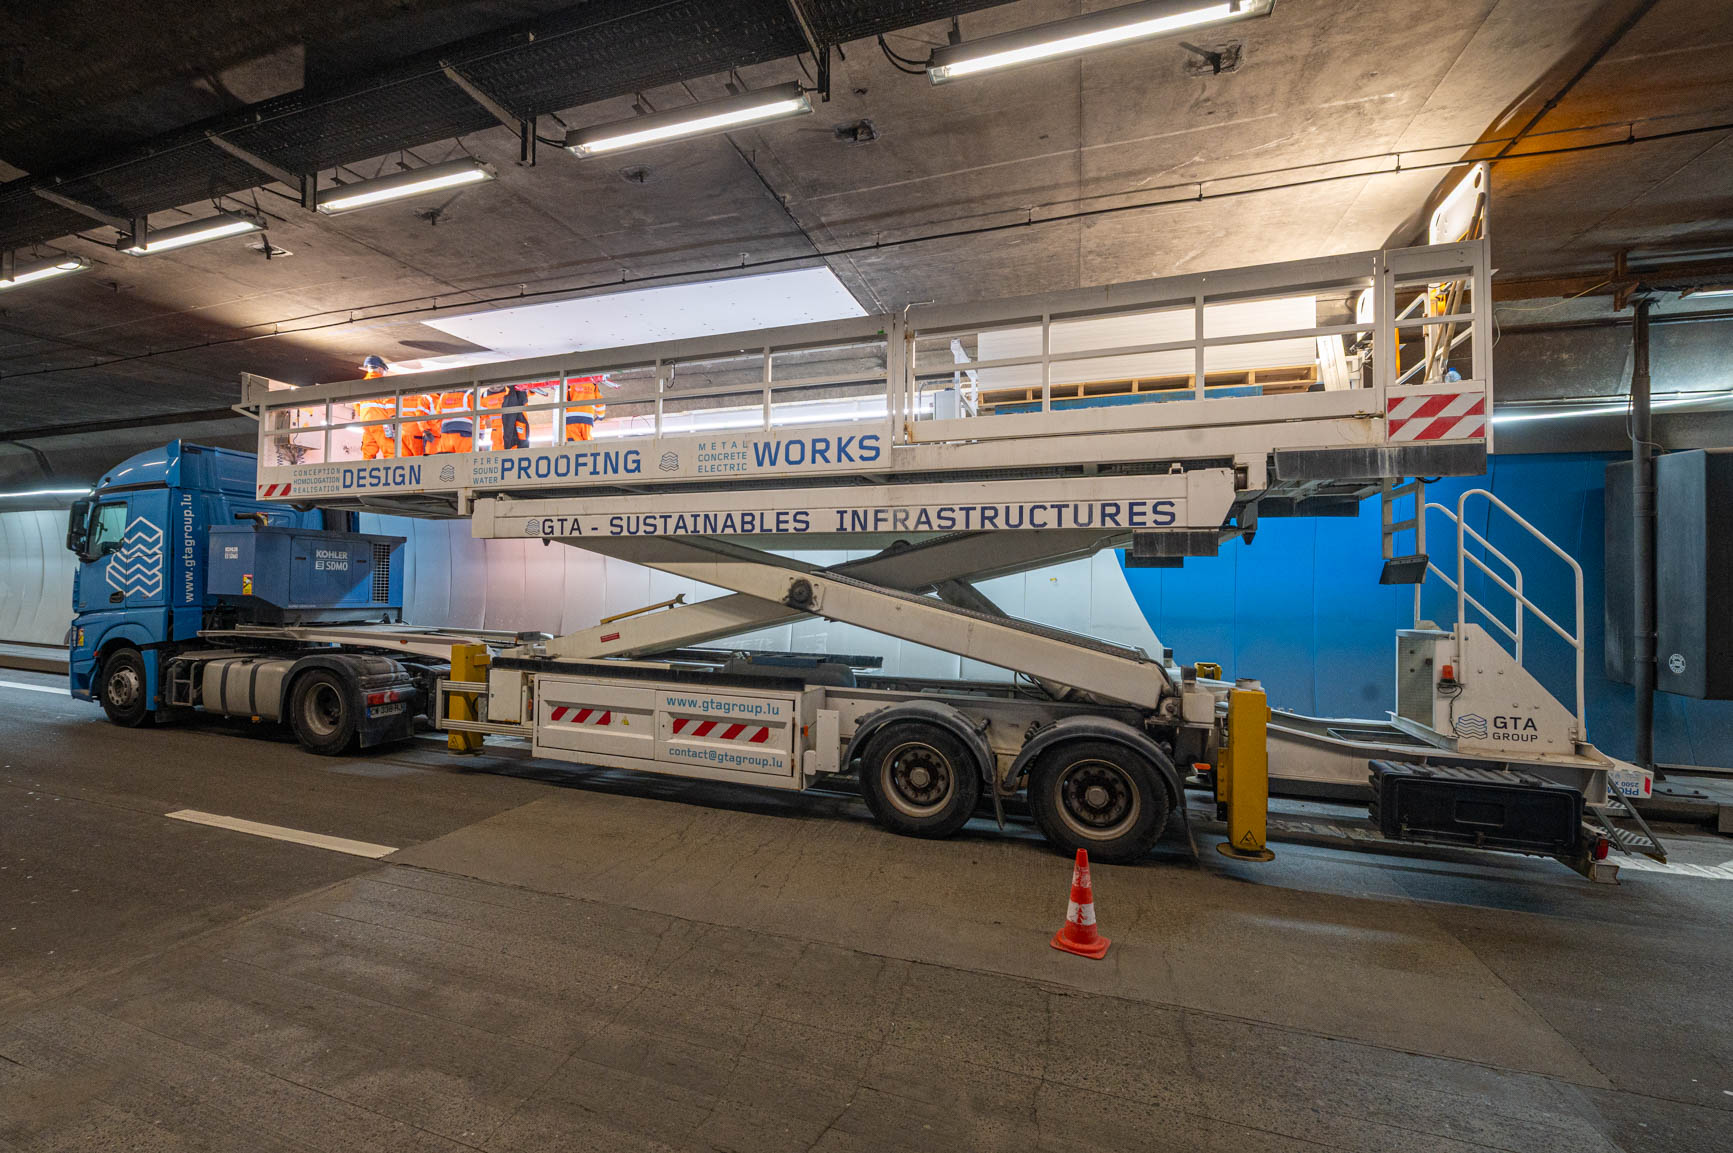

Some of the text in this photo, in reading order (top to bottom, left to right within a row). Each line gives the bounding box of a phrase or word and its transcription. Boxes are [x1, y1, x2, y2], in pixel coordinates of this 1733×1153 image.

[698, 440, 748, 451] METAL
[753, 434, 881, 468] WORKS
[473, 456, 499, 465] FIRE
[697, 451, 748, 462] CONCRETE
[472, 466, 499, 475] SOUND
[500, 450, 642, 481] PROOFING
[697, 462, 748, 473] ELECTRIC
[293, 467, 341, 477] CONCEPTION
[342, 464, 422, 489] DESIGN
[293, 476, 341, 485] HOMOLOGATION
[472, 476, 499, 485] WATER
[293, 485, 341, 494] REALISATION
[541, 518, 583, 536] GTA
[610, 510, 810, 536] SUSTAINABLES
[836, 500, 1177, 532] INFRASTRUCTURES
[180, 493, 196, 603] www.gtagroup.lu
[315, 549, 347, 560] KOHLER
[325, 560, 348, 571] SDMO
[666, 696, 780, 716] www.gtagroup.lu
[1493, 715, 1538, 731] GTA
[1492, 732, 1538, 743] GROUP
[668, 745, 783, 769] contact@gtagroup.lu
